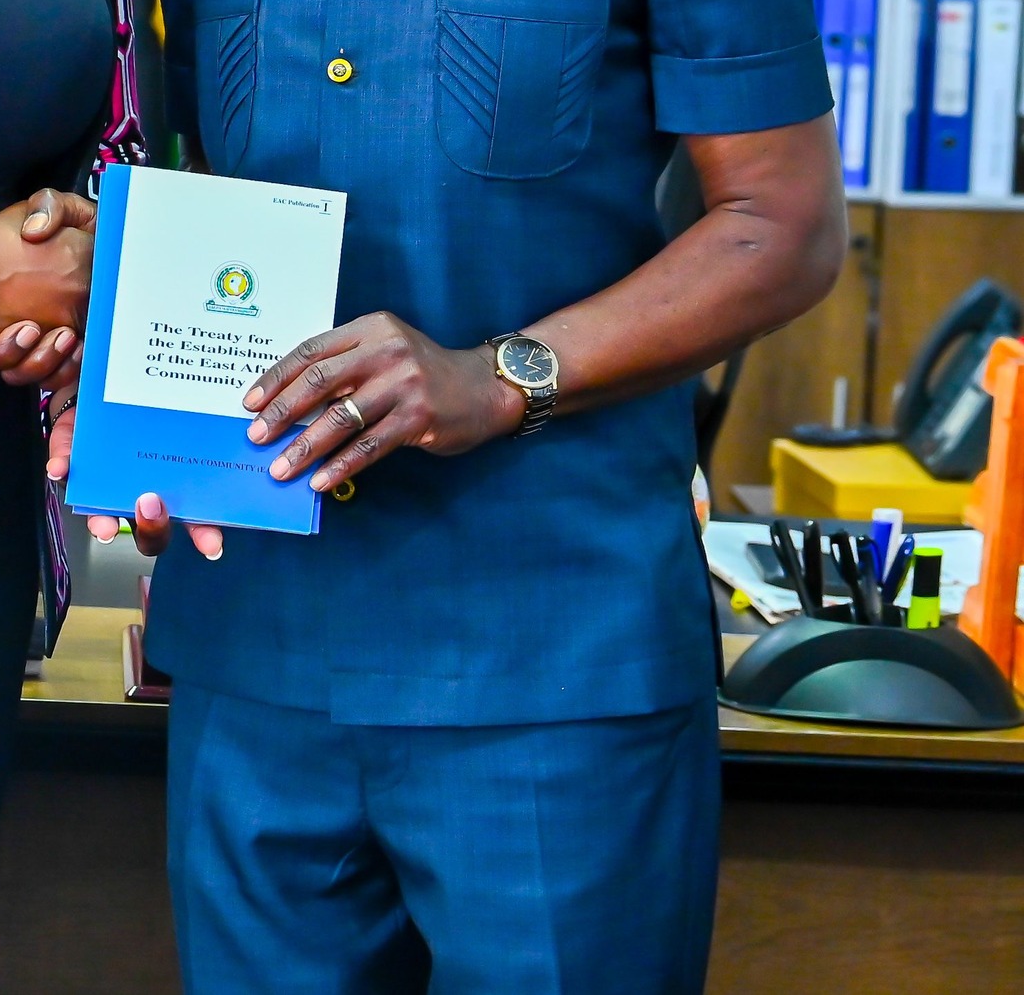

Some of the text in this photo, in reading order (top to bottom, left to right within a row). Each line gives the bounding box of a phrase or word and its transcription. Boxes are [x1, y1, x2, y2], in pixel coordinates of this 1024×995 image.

[272, 197, 287, 205] EAC
[288, 199, 320, 209] Publication
[148, 337, 175, 349] the
[150, 321, 273, 346] The Treaty for
[146, 352, 165, 362] of
[168, 354, 194, 366] the
[199, 357, 237, 371] East
[145, 365, 246, 389] Community
[137, 450, 158, 461] EAST
[160, 453, 199, 466] AFRICAN
[200, 458, 256, 473] COMMUNITY
